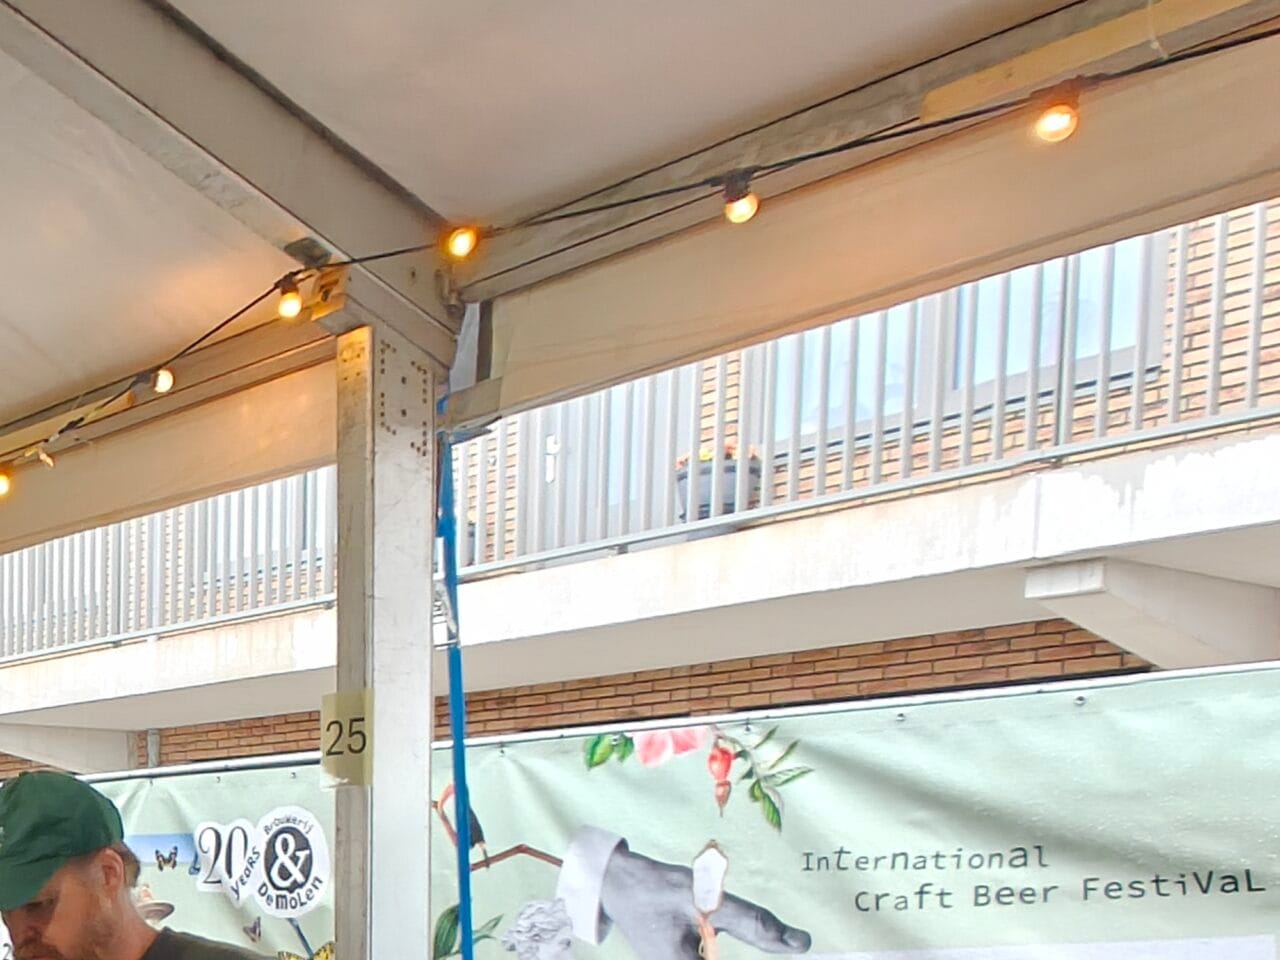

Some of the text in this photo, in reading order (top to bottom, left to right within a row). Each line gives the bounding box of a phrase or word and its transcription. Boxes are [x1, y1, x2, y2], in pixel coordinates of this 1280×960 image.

[326, 717, 367, 757] 25
[198, 826, 248, 884] 20
[973, 883, 1060, 908] Beer
